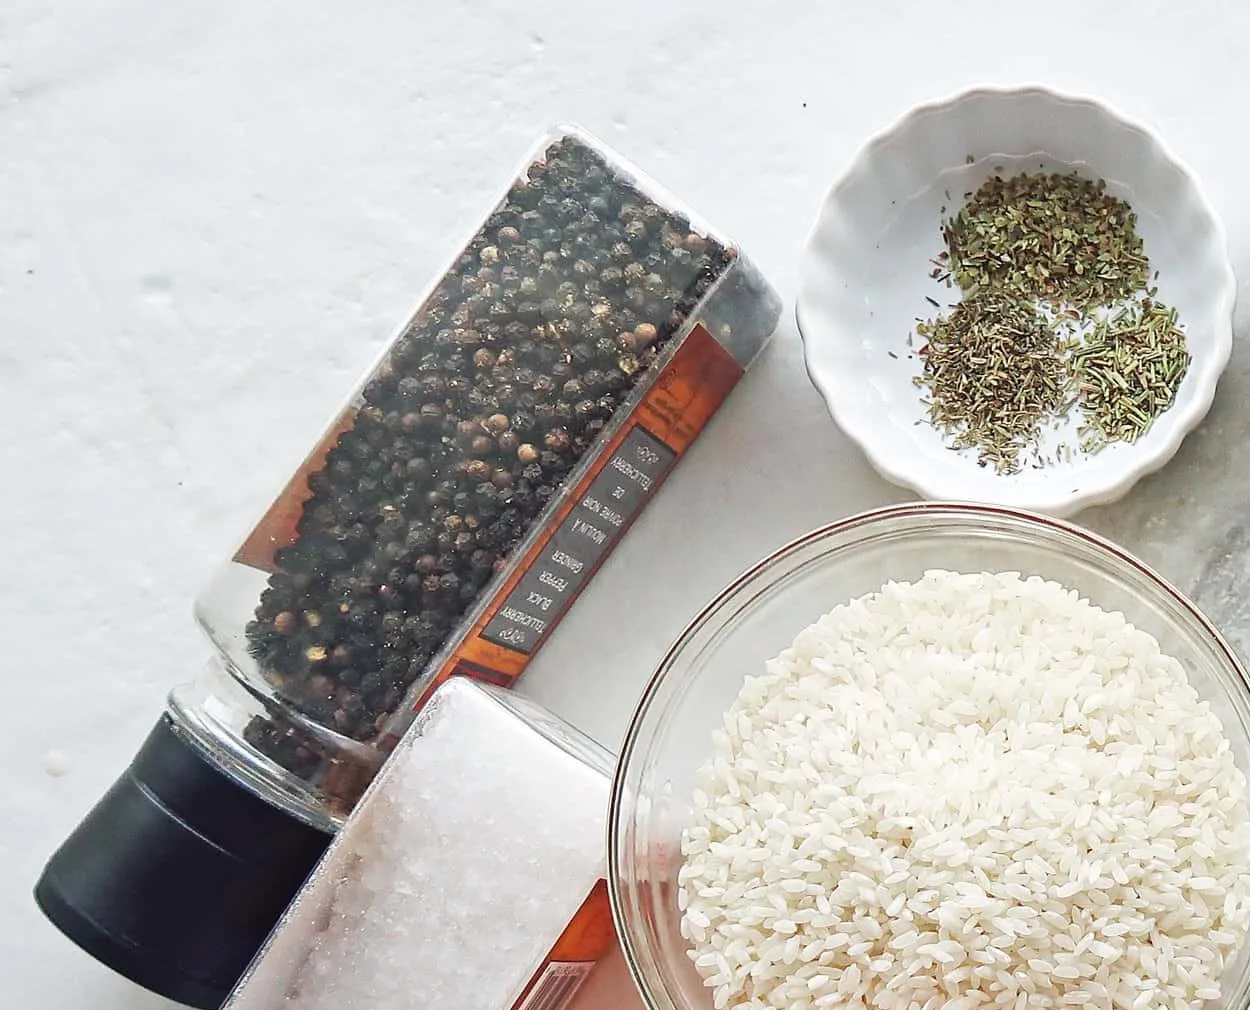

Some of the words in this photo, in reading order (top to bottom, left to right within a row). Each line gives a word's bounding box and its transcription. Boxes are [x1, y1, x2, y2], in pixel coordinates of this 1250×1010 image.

[610, 456, 653, 492] TELLICHERRY
[539, 570, 569, 592] PEPPER
[526, 591, 553, 611] BLACK
[500, 606, 546, 633] TELLICHERRY
